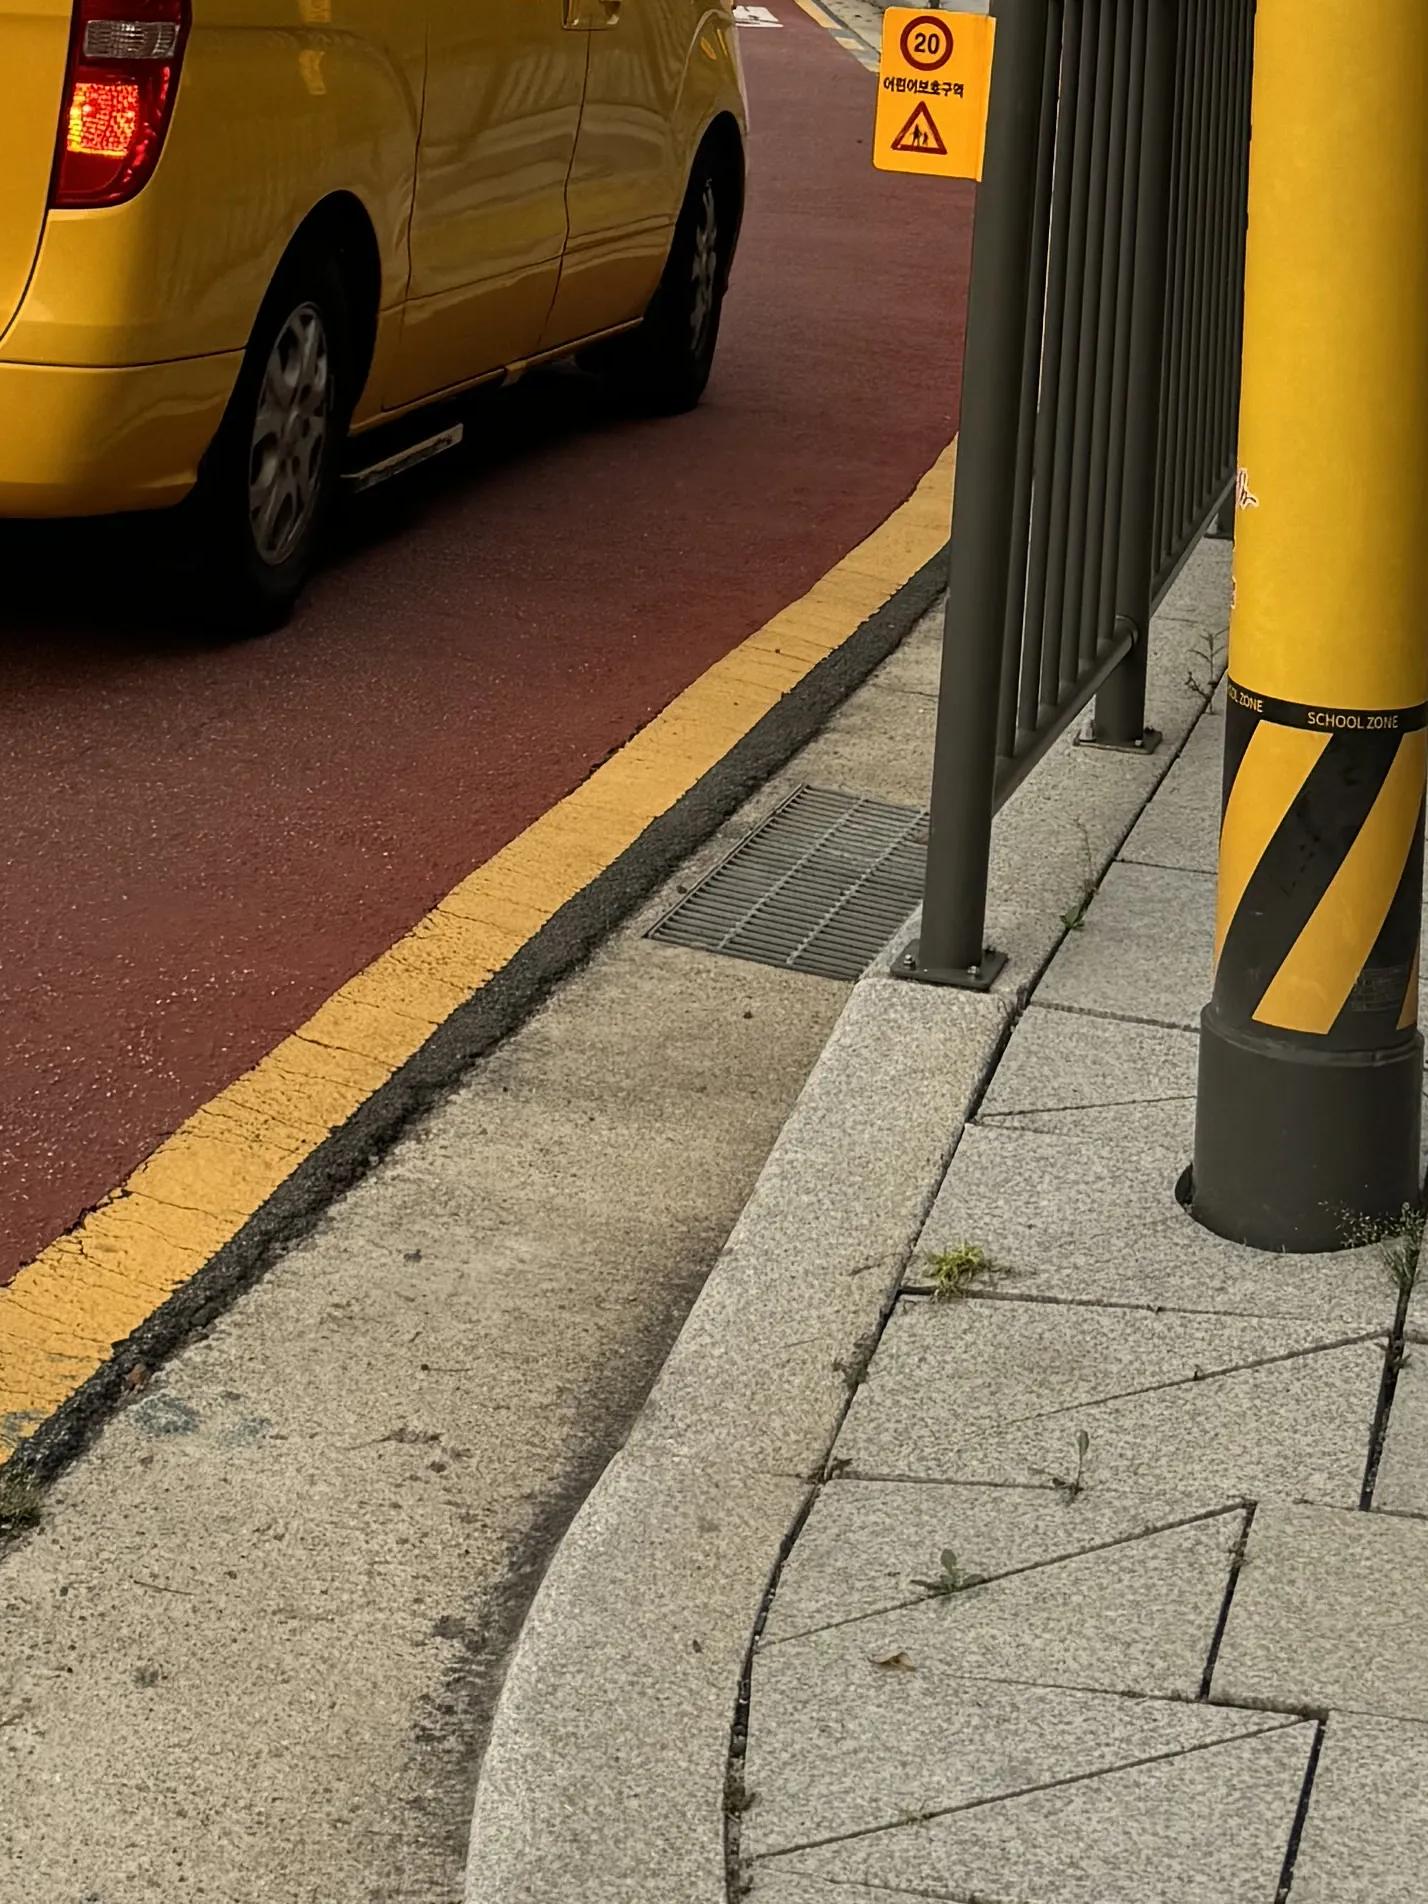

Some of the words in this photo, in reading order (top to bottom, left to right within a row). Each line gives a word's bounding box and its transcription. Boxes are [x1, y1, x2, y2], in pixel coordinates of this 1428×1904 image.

[914, 32, 940, 55] 20
[883, 77, 965, 98] 어린이보호구역
[1239, 692, 1264, 713] ZONE
[1307, 711, 1365, 730] SCHOOL
[1366, 714, 1398, 730] ZONE
